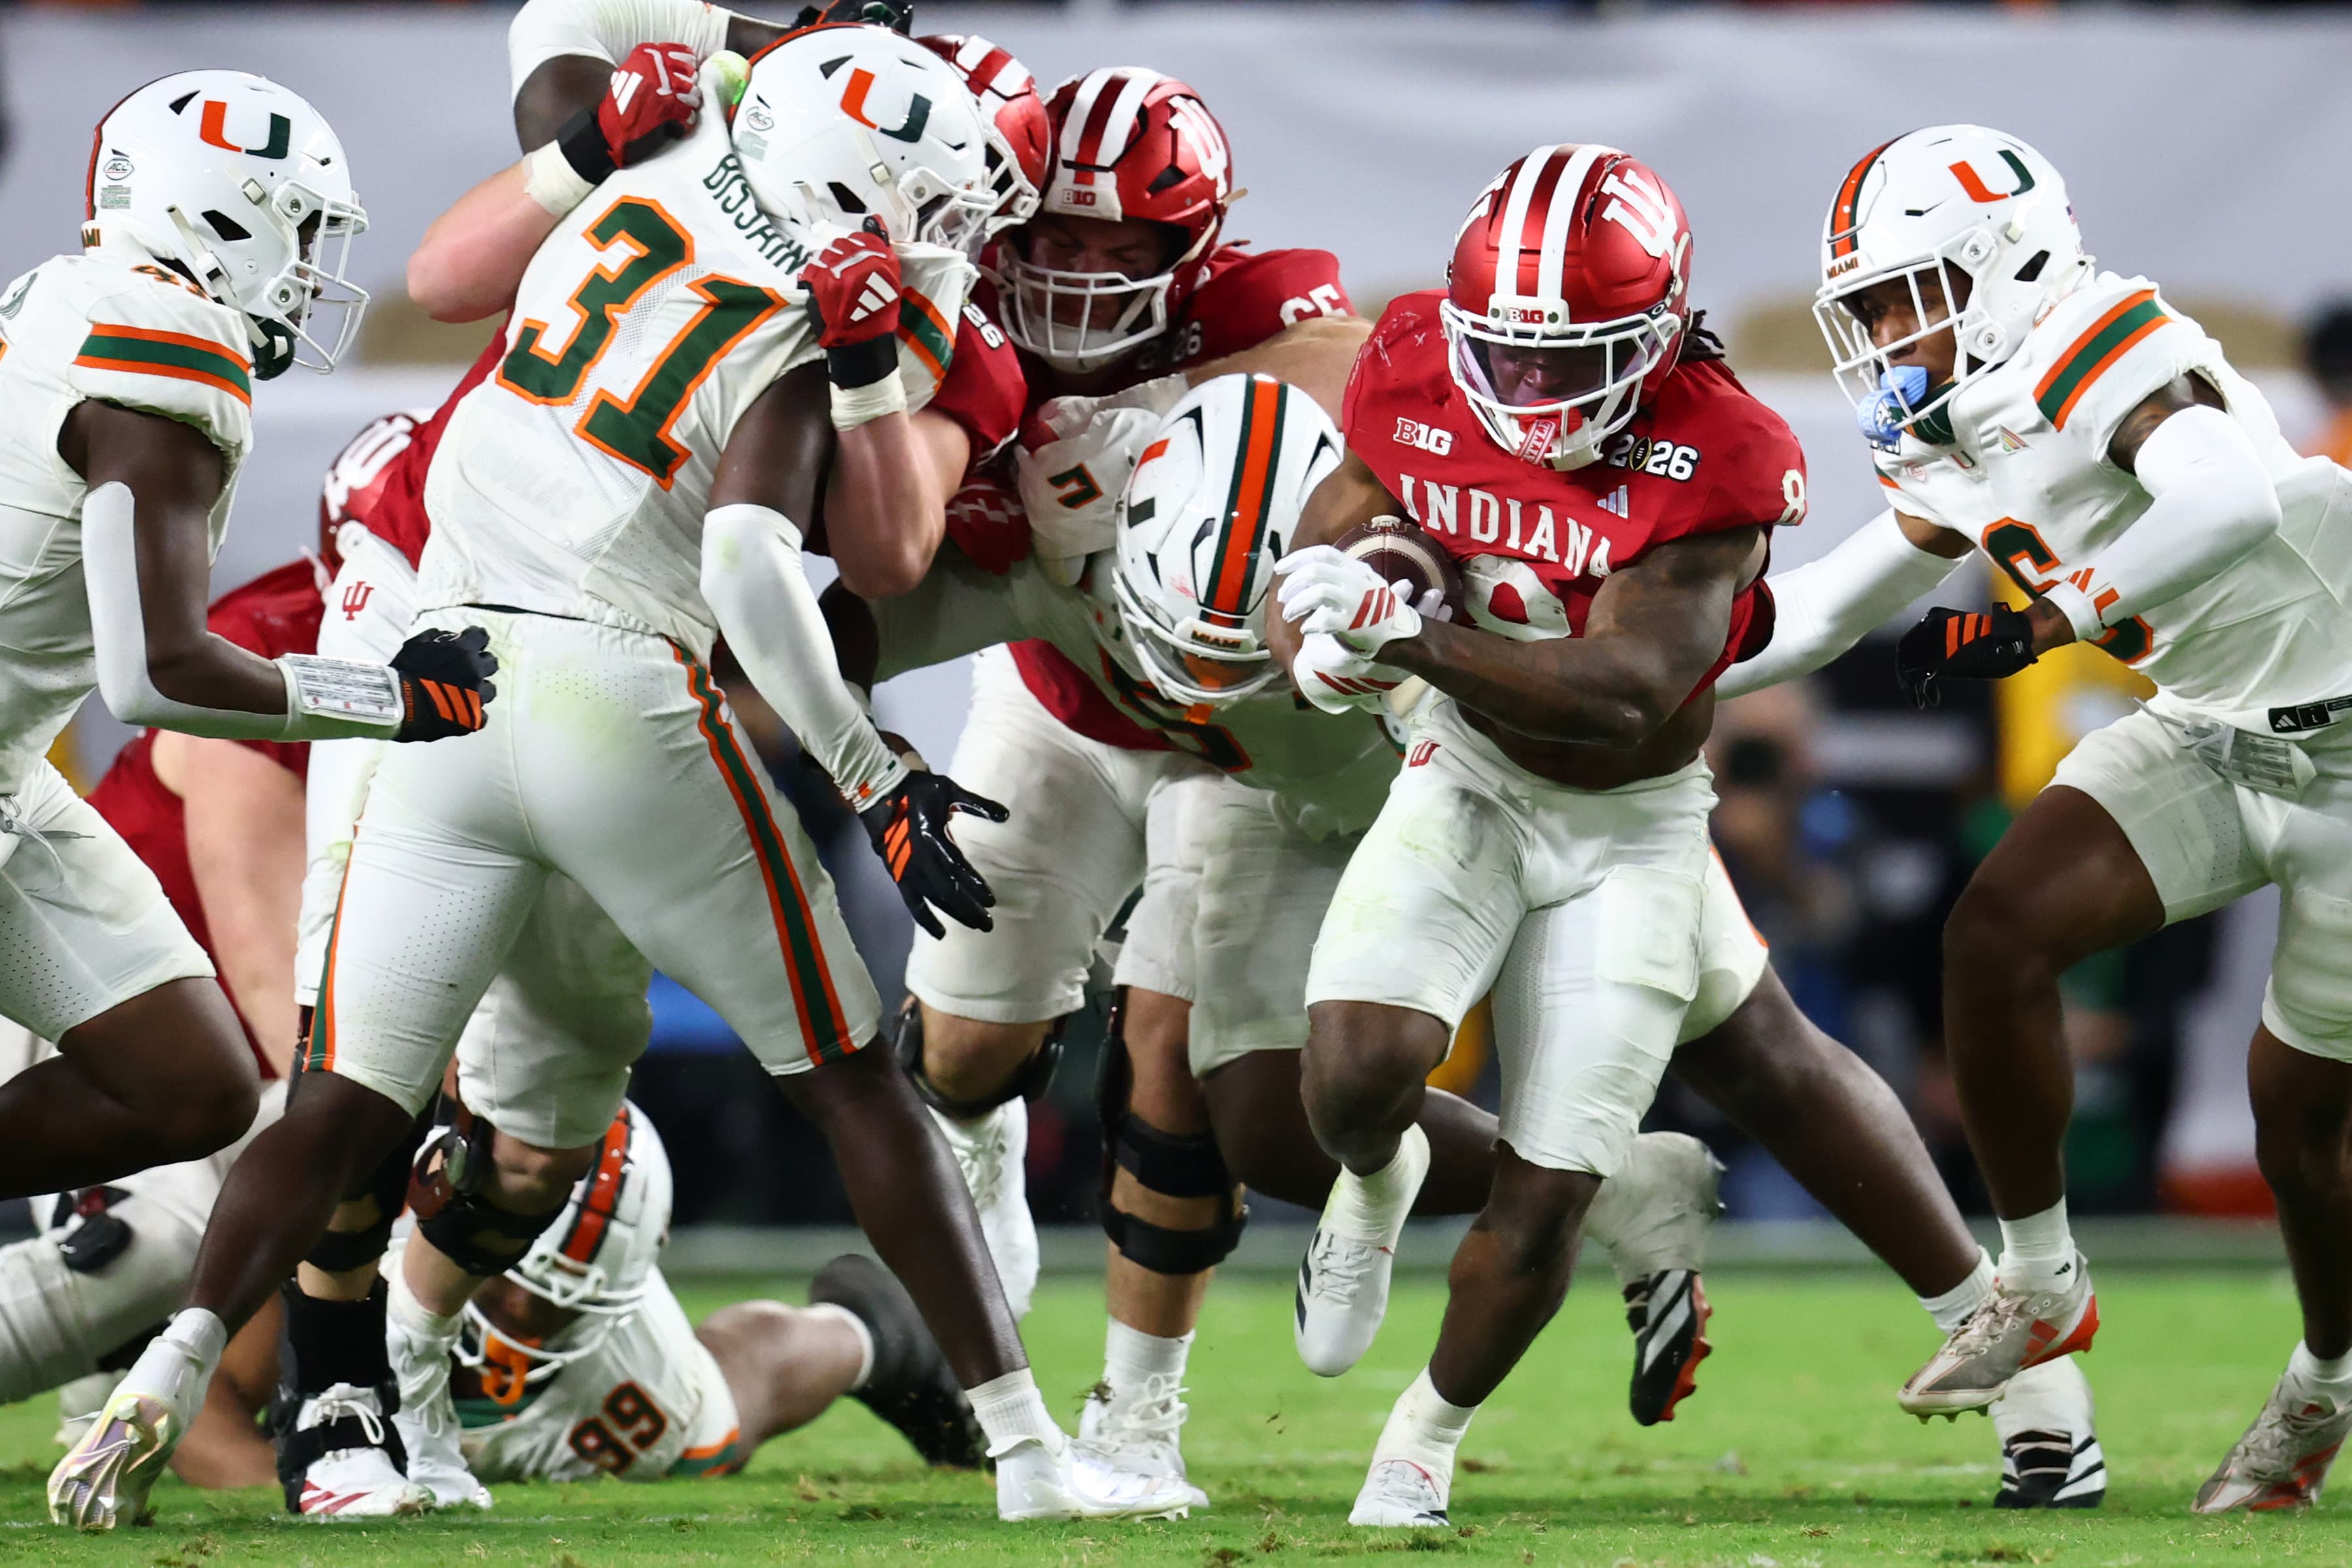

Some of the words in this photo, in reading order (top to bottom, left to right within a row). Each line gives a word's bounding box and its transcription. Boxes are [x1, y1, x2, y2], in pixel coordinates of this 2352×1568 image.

[200, 101, 291, 159] U
[1948, 150, 2036, 203] U
[1827, 256, 1859, 280] MIAMI
[496, 195, 789, 492] 31
[1399, 473, 1612, 579] INDIANA
[569, 1380, 667, 1477] 99
